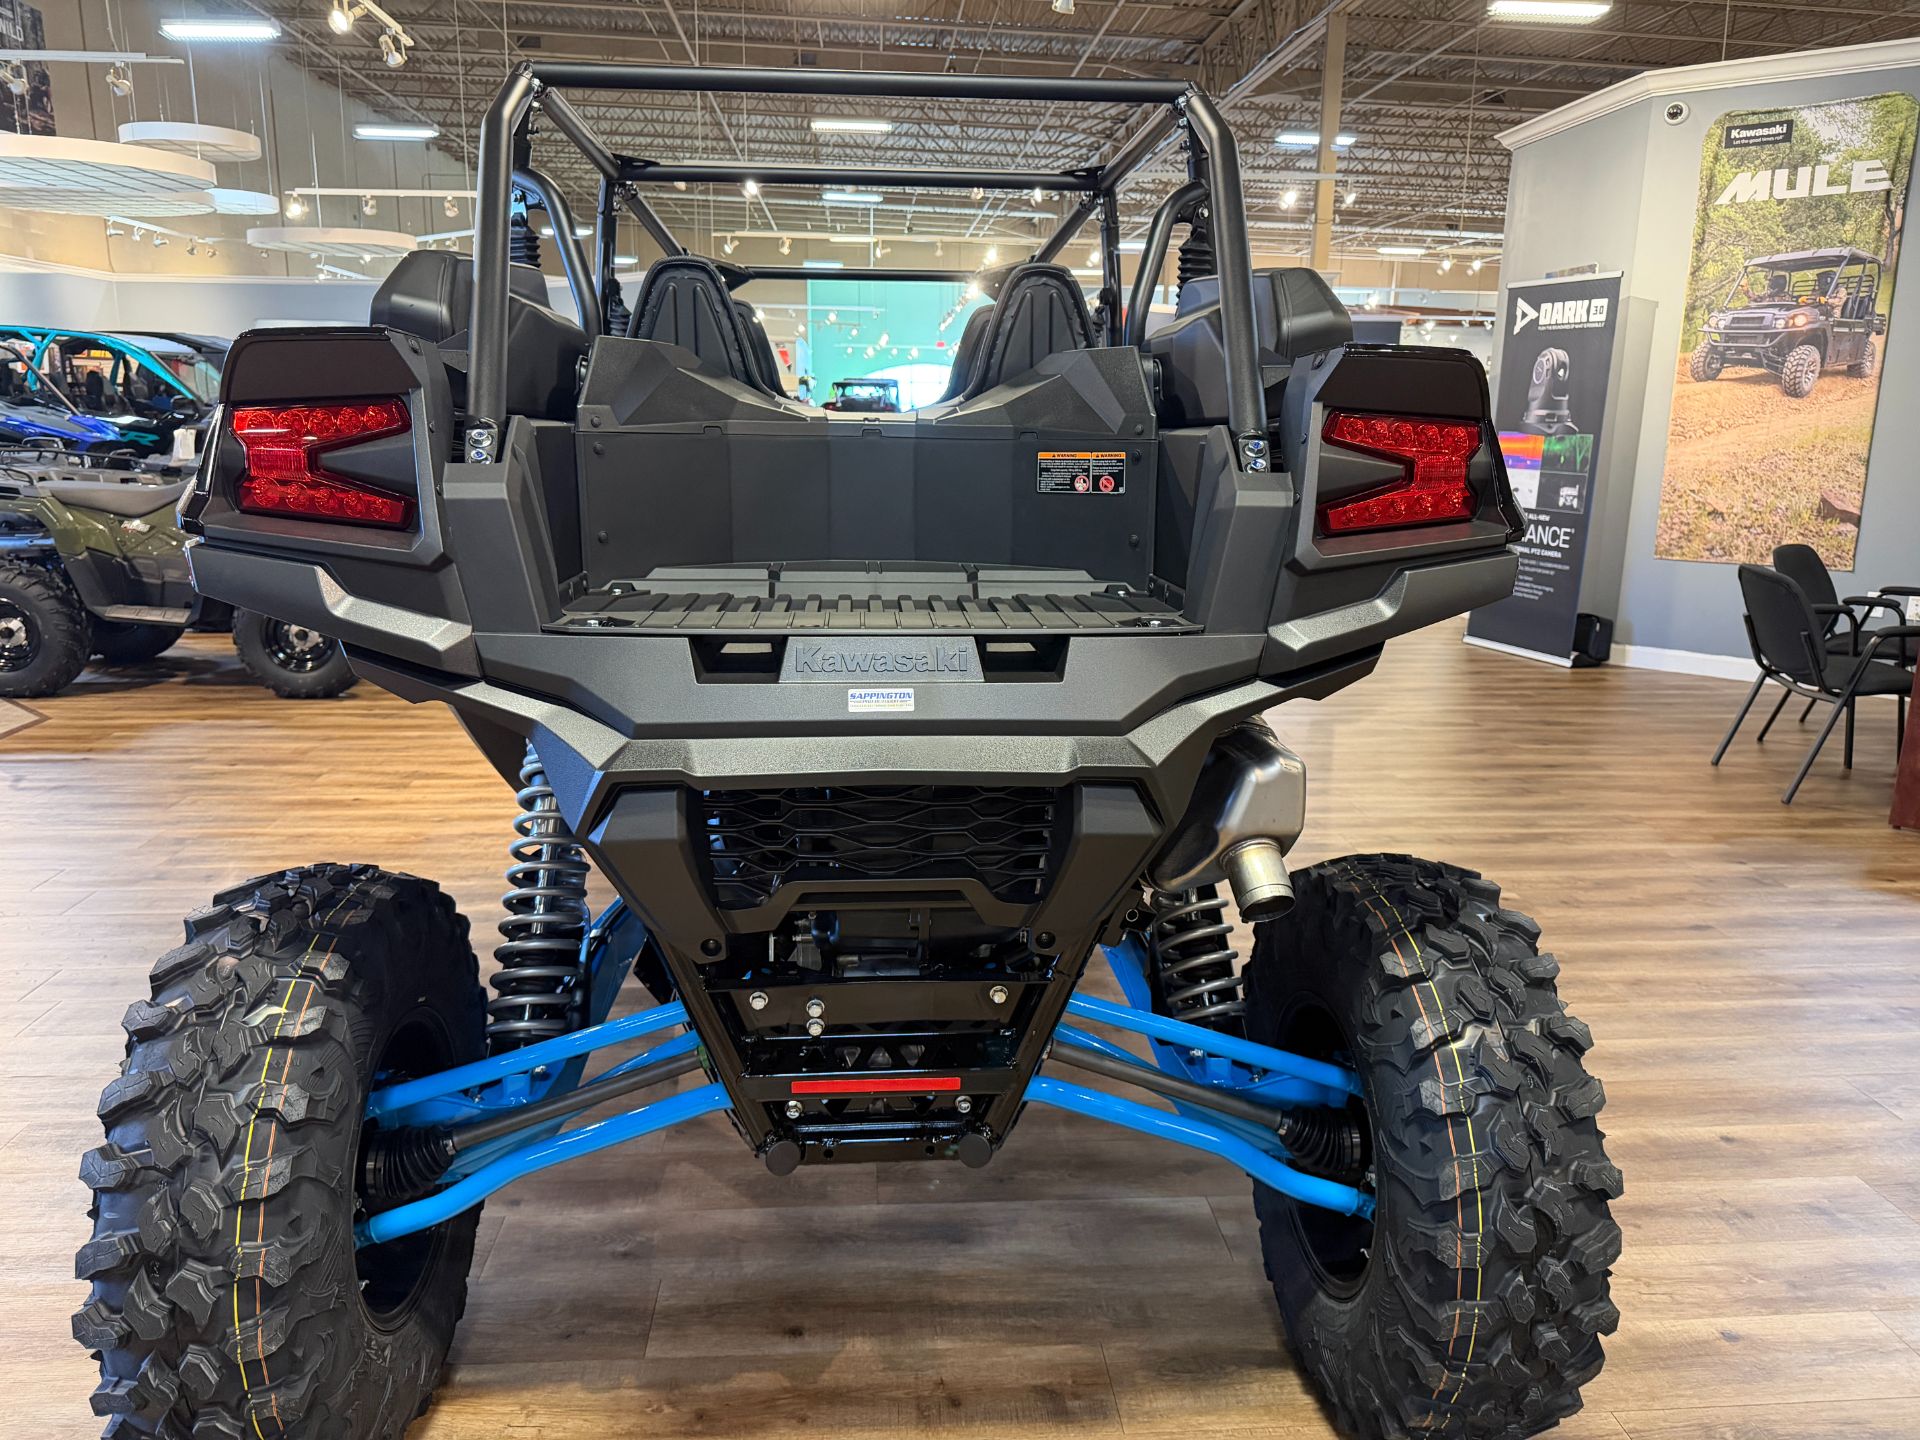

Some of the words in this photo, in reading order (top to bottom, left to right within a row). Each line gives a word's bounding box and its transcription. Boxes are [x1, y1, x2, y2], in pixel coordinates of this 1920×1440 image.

[1731, 124, 1787, 139] Kawasaki
[1714, 159, 1893, 205] MULE
[1539, 299, 1589, 325] DARK
[795, 645, 968, 673] Kawasaki
[849, 692, 913, 700] SAPPINGTON
